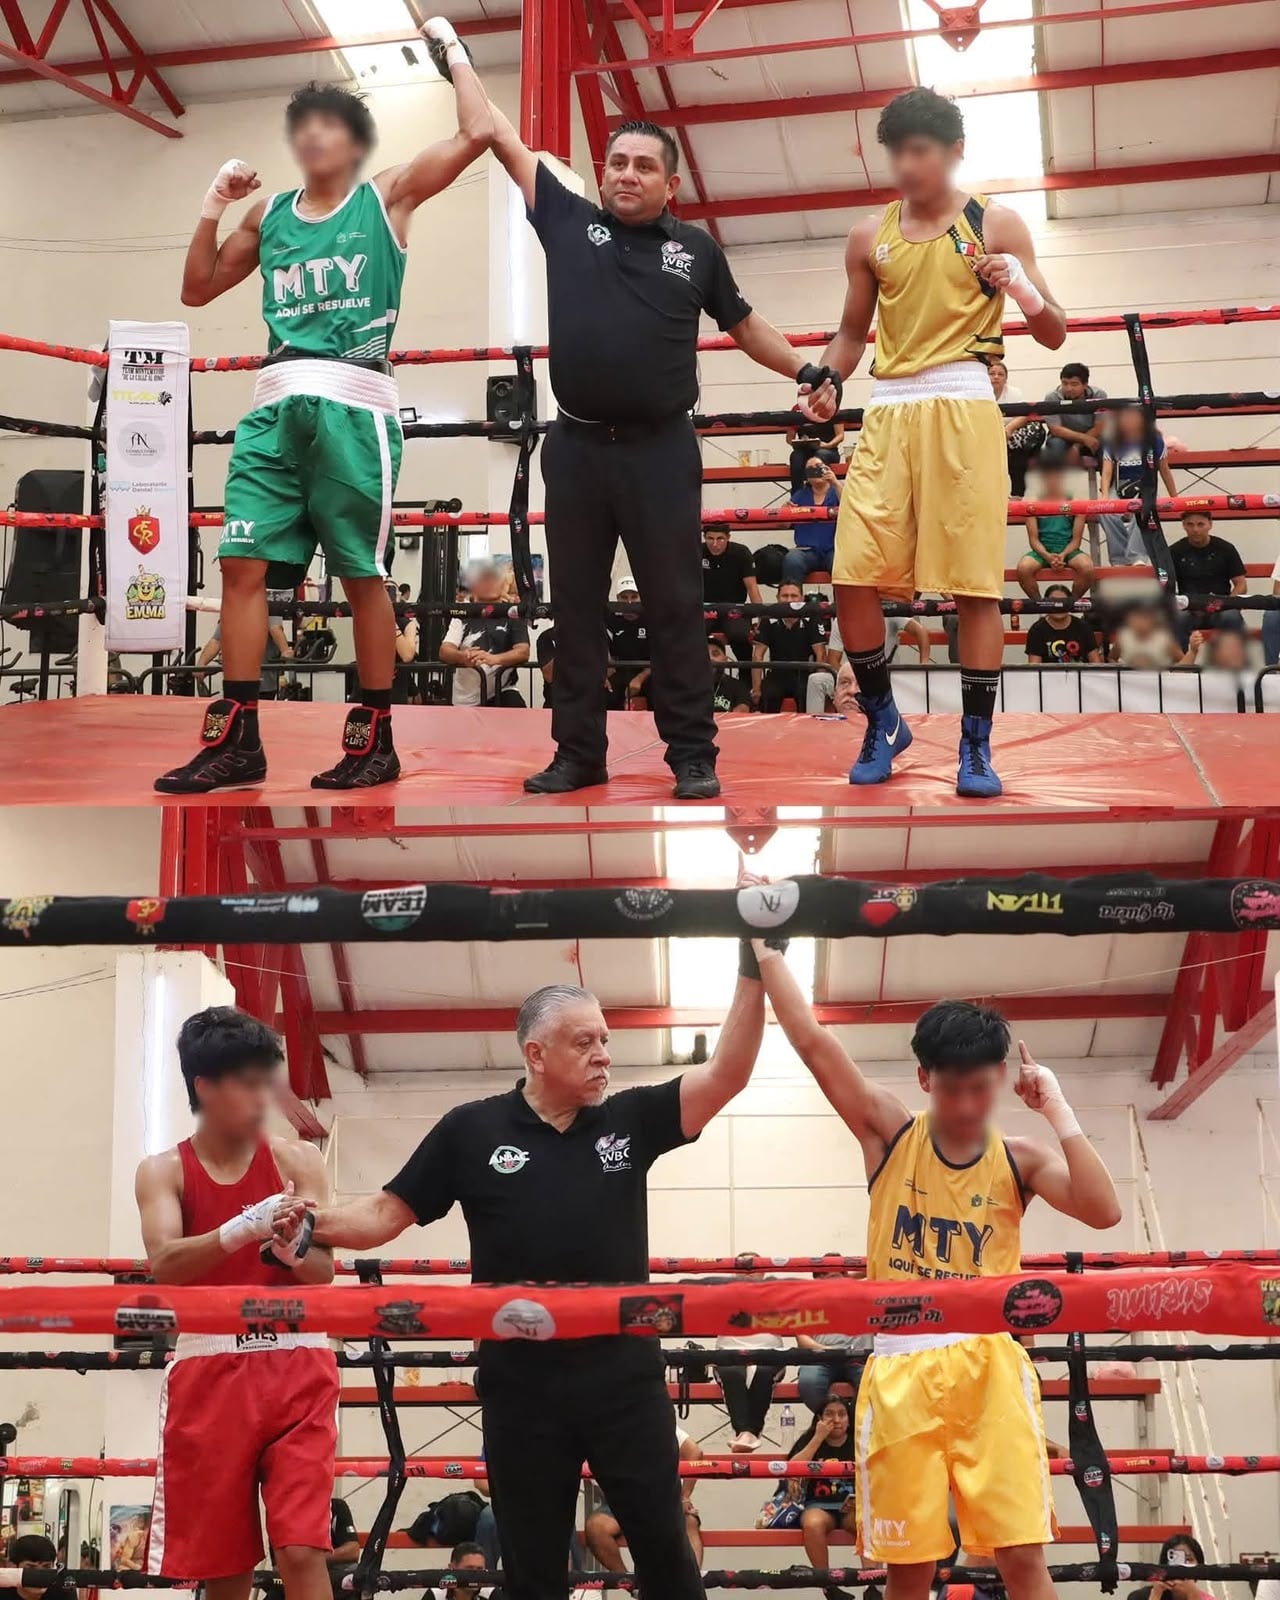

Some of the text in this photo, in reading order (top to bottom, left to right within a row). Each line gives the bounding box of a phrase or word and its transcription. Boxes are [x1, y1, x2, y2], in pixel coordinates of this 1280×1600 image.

[663, 256, 691, 272] WBC
[273, 254, 368, 304] MTY
[302, 304, 315, 314] SE
[317, 297, 371, 312] RESUELVE
[124, 351, 164, 364] TM
[126, 605, 166, 619] EMMA
[363, 897, 424, 913] TEAM
[600, 1147, 630, 1163] WBC
[892, 1205, 993, 1267] MTY
[917, 1265, 932, 1278] SE
